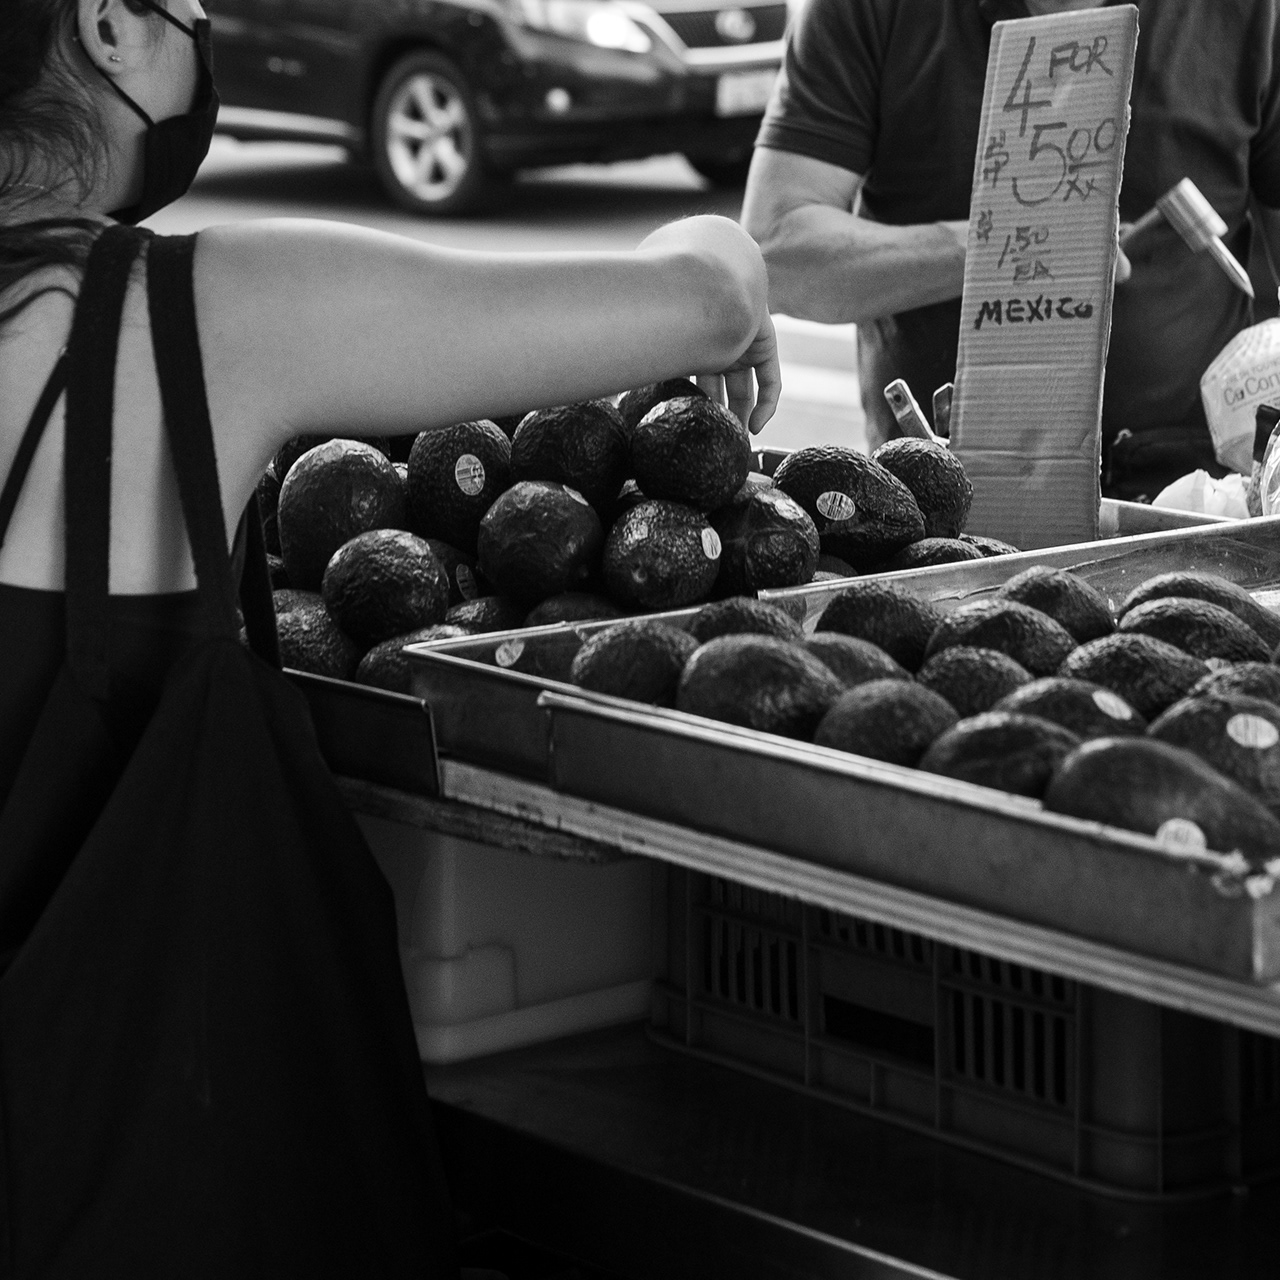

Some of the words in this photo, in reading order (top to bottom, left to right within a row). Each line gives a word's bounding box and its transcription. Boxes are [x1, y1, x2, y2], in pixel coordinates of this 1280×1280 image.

[1002, 36, 1053, 139] 4
[1048, 35, 1115, 80] FOR
[974, 294, 1094, 331] MEXICO
